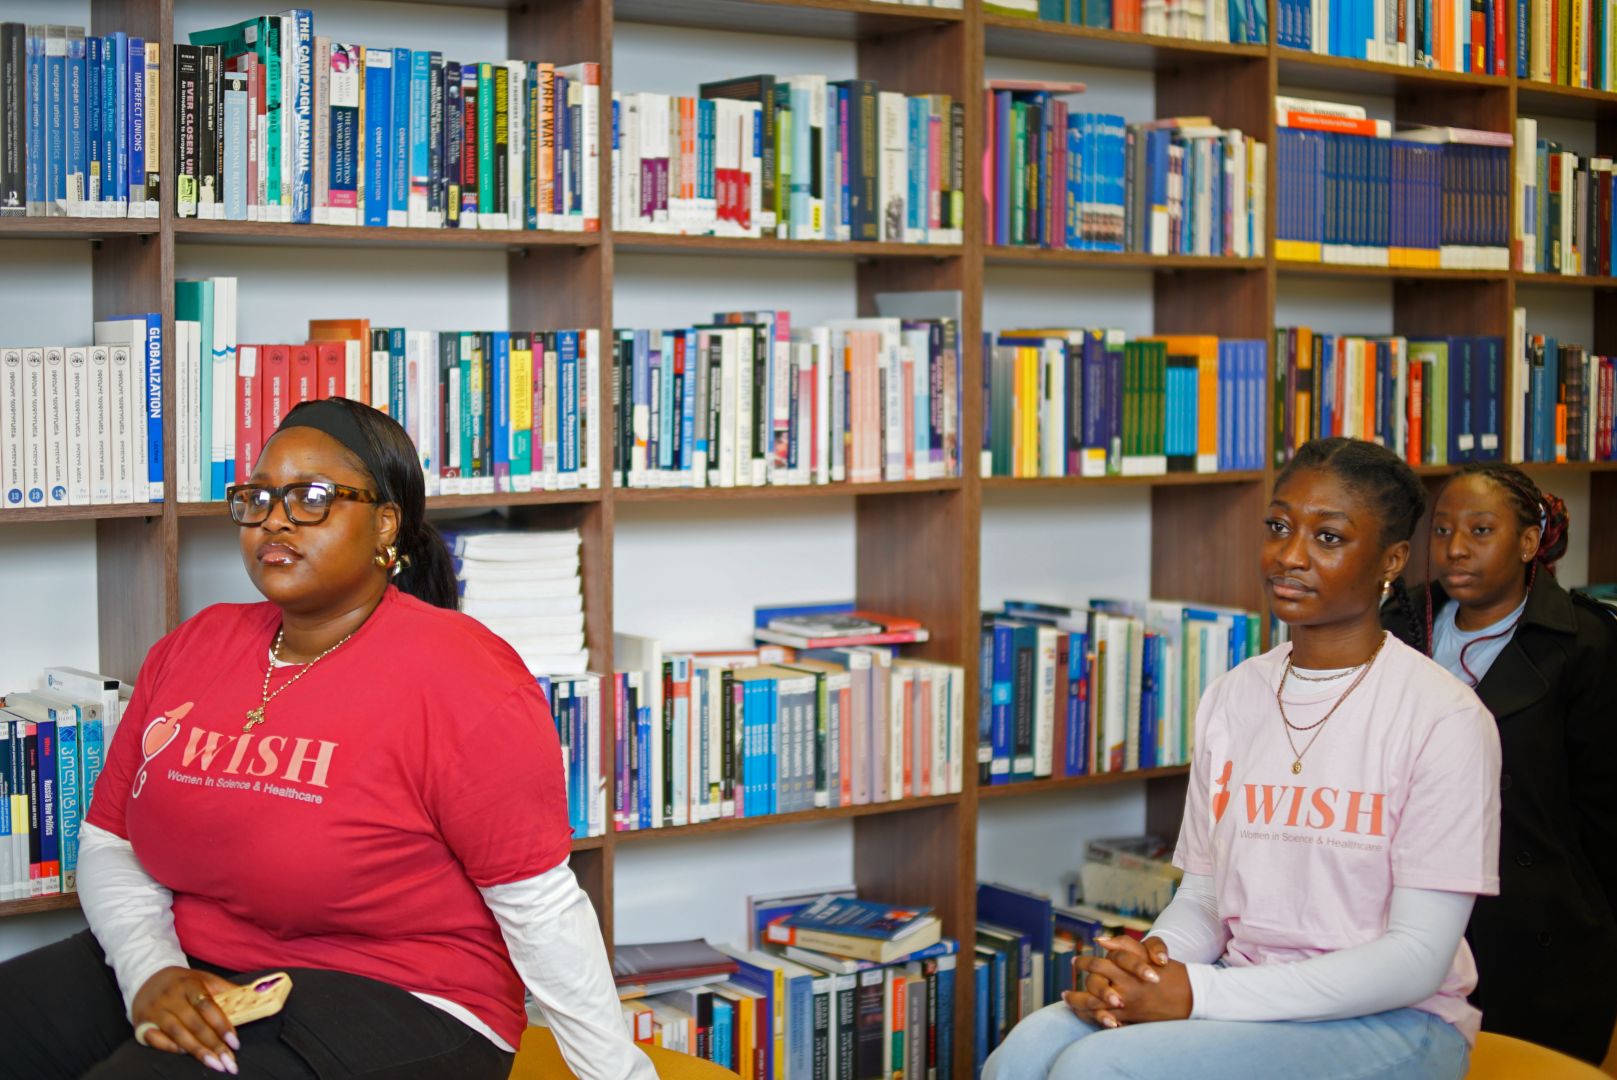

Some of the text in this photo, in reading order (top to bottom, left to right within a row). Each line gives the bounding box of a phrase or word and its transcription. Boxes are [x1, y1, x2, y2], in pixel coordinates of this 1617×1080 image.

[72, 66, 80, 103] european
[180, 80, 186, 90] An
[299, 16, 310, 173] THE CAMPAIGN MANUAL
[541, 71, 554, 148] CYBER WAR
[31, 64, 39, 159] european union politics
[52, 64, 61, 160] european union politics
[336, 111, 343, 120] OF
[496, 114, 507, 145] CHALLENGE
[72, 131, 80, 160] politics
[465, 102, 475, 184] CAMPAIGN MANAGER
[150, 327, 160, 418] GLOBALIZATION
[889, 346, 898, 427] COMPARATIVE POLITICS
[11, 492, 19, 500] 13
[32, 492, 40, 500] 13
[181, 727, 338, 788] WISH
[44, 780, 53, 836] Russia's New Politics
[61, 747, 77, 838] პოლიტიკა
[167, 769, 323, 804] Women in Science & Healthcare
[1243, 784, 1386, 837] WISH
[1240, 830, 1382, 852] Women in Science & Healthcare
[896, 984, 905, 1030] Nationalism
